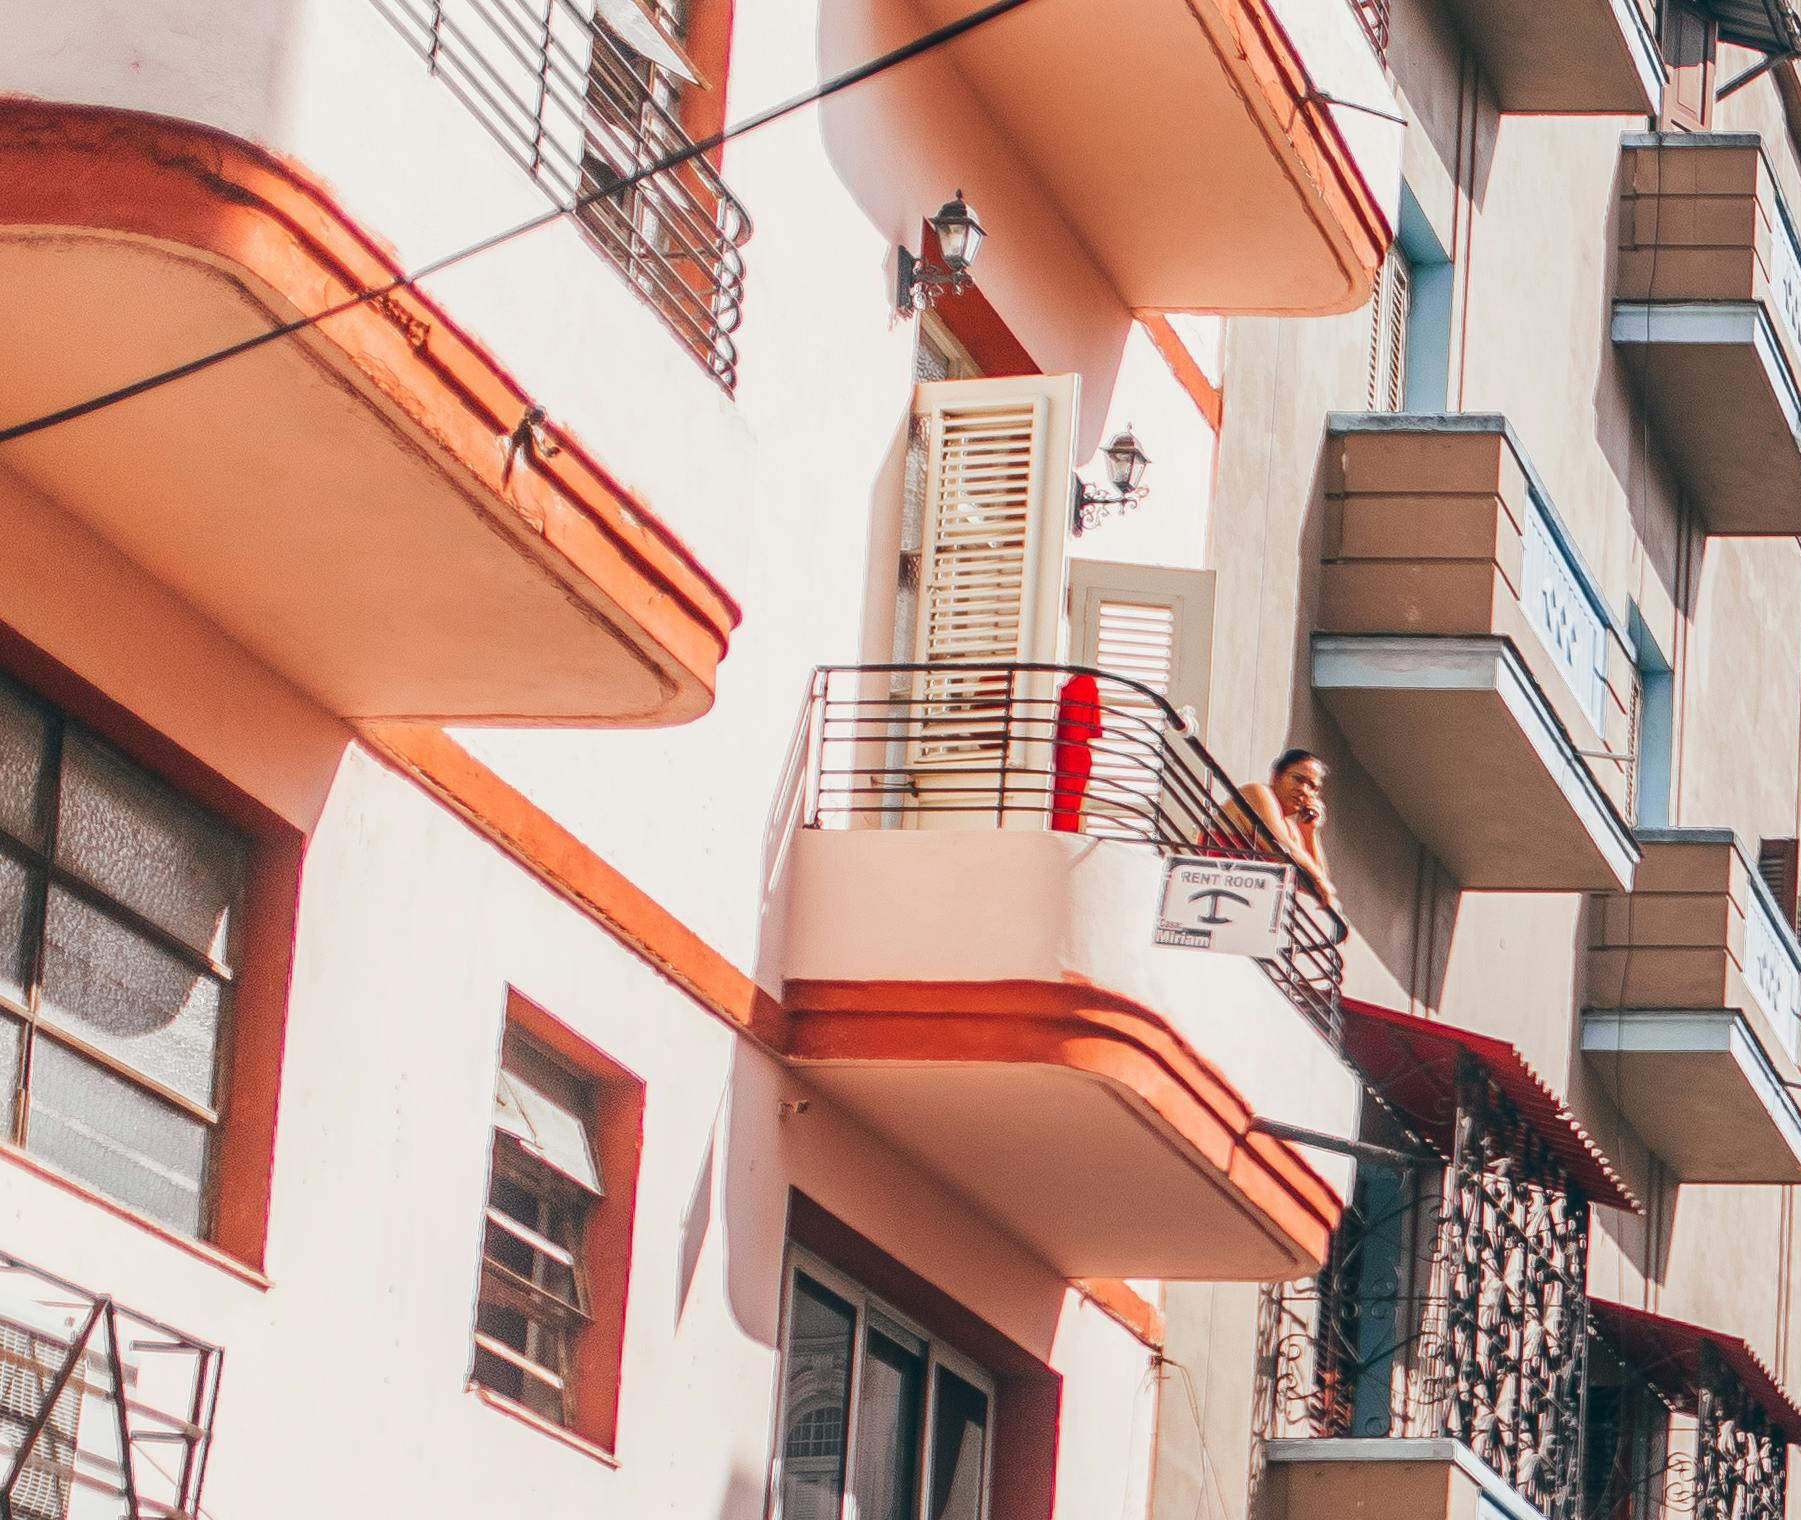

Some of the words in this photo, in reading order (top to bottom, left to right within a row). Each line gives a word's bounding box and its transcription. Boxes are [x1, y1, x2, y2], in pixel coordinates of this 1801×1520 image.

[1181, 871, 1220, 885] RENT
[1224, 874, 1266, 889] ROOM
[1156, 930, 1210, 947] Miriam
